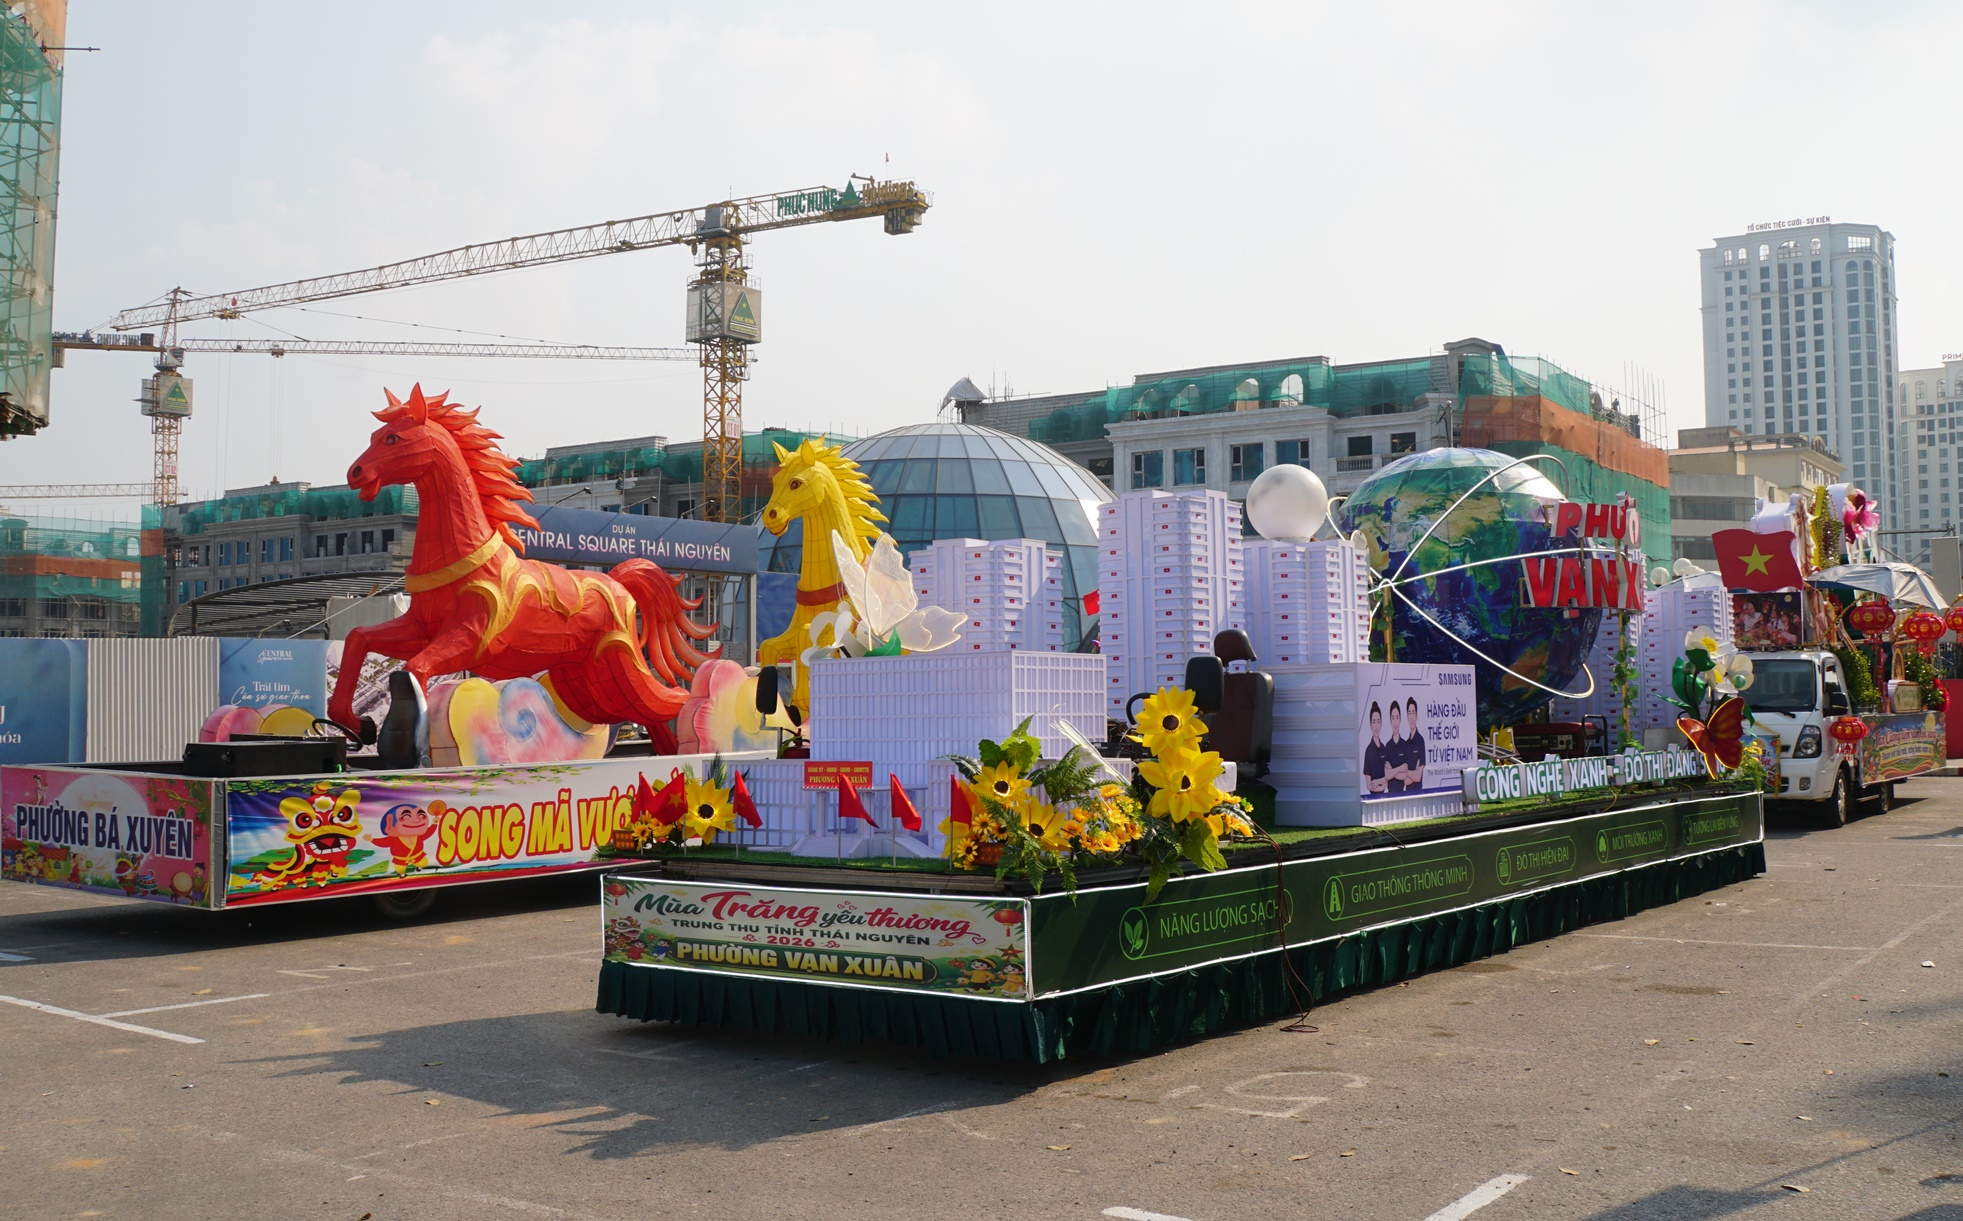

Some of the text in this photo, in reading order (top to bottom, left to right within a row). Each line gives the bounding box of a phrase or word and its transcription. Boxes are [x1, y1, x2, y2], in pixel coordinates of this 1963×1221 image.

[612, 524, 636, 535] DỰ ÁN
[578, 534, 635, 555] SQUARE
[640, 537, 670, 558] THÁI
[675, 542, 730, 562] NGUYÊN
[253, 681, 290, 692] Trái tim
[1438, 673, 1472, 686] SAMSUNG
[1426, 697, 1467, 718] HÀNG ĐẦU
[0, 731, 21, 744] óa
[1427, 720, 1460, 741] THẾ GIỚI
[1427, 745, 1473, 766] TỪ VIỆT NAM
[1476, 760, 1520, 801] CÔNG
[1526, 754, 1564, 799] NGHỆ
[1568, 757, 1608, 790] XANH
[1624, 750, 1644, 783] ĐÔ
[1645, 752, 1664, 785] THỊ
[1666, 746, 1697, 778] ĐÁNG
[16, 800, 193, 859] PHƯỜNG BÁ XUYÊN
[436, 803, 525, 866] SONG
[526, 788, 572, 856] MÃ
[1612, 833, 1624, 851] MÔI
[1648, 829, 1663, 844] XANH
[1517, 846, 1569, 870] ĐÔ THỊ HIỆN ĐẠI
[1351, 865, 1468, 903] GIAO THÔNG THÔNG MINH
[633, 891, 981, 939] Mùa Trăng yêu thương
[1160, 912, 1200, 939] NĂNG
[1203, 905, 1248, 933] LƯỢNG
[671, 918, 930, 946] TRUNG THU TỈNH THÁI NGUYÊN
[766, 935, 816, 948] 2026
[676, 942, 924, 980] PHƯỜNG VẠN XUÂN
